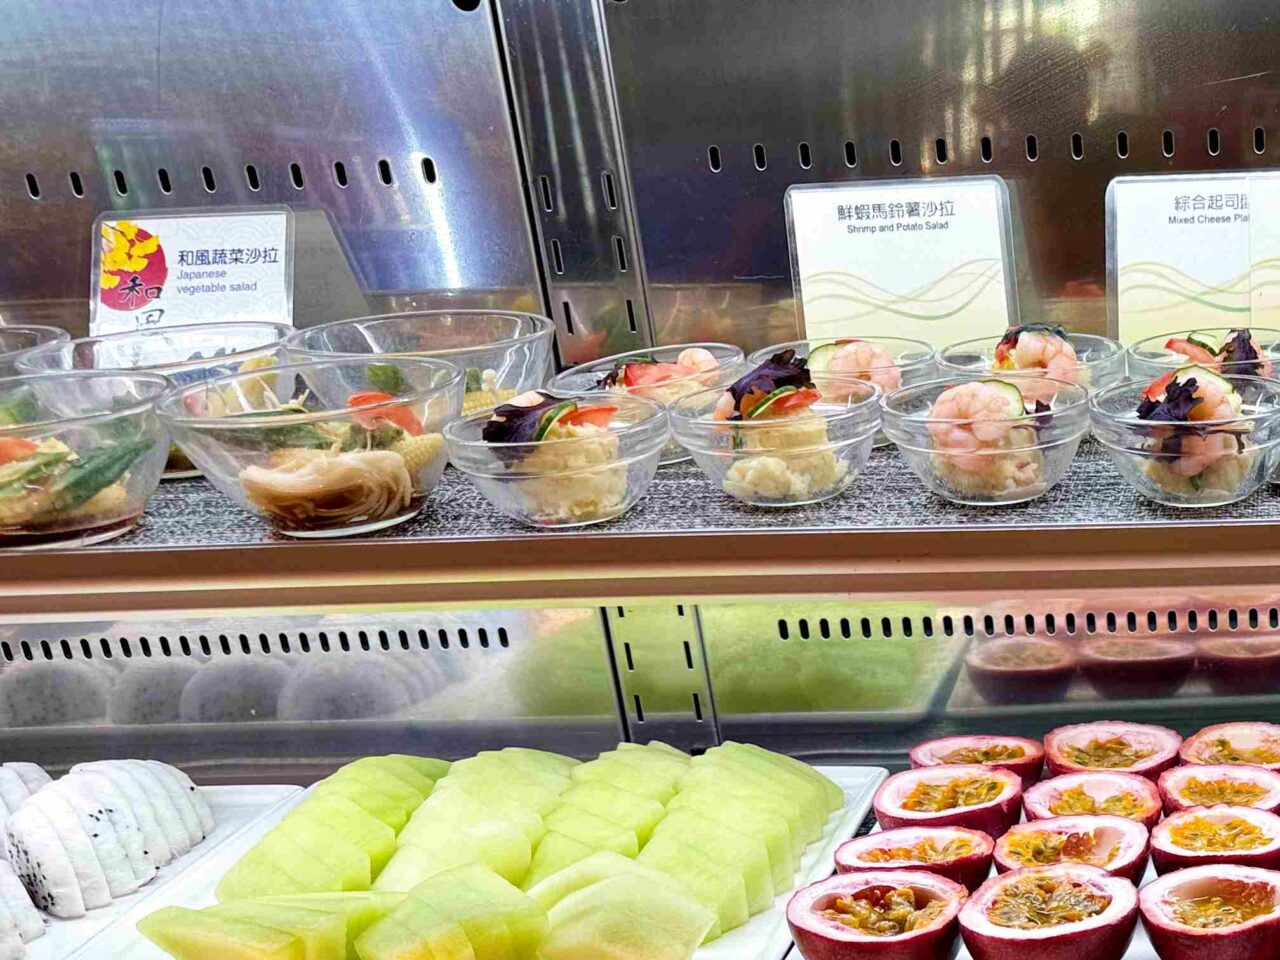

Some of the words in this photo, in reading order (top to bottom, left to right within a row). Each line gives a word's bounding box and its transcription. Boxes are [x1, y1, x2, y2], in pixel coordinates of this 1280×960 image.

[837, 200, 955, 221] 鮮蝦馬鈴薯沙拉
[1168, 215, 1195, 224] Mixed
[1197, 214, 1231, 224] Cheese
[847, 224, 877, 235] Shrimp
[878, 223, 894, 233] and
[896, 222, 923, 232] Potato
[925, 221, 949, 231] Salad
[177, 247, 279, 267] 和風蔬菜沙拉
[177, 268, 227, 281] Japanese
[177, 282, 227, 295] vegetable
[230, 280, 257, 292] salad
